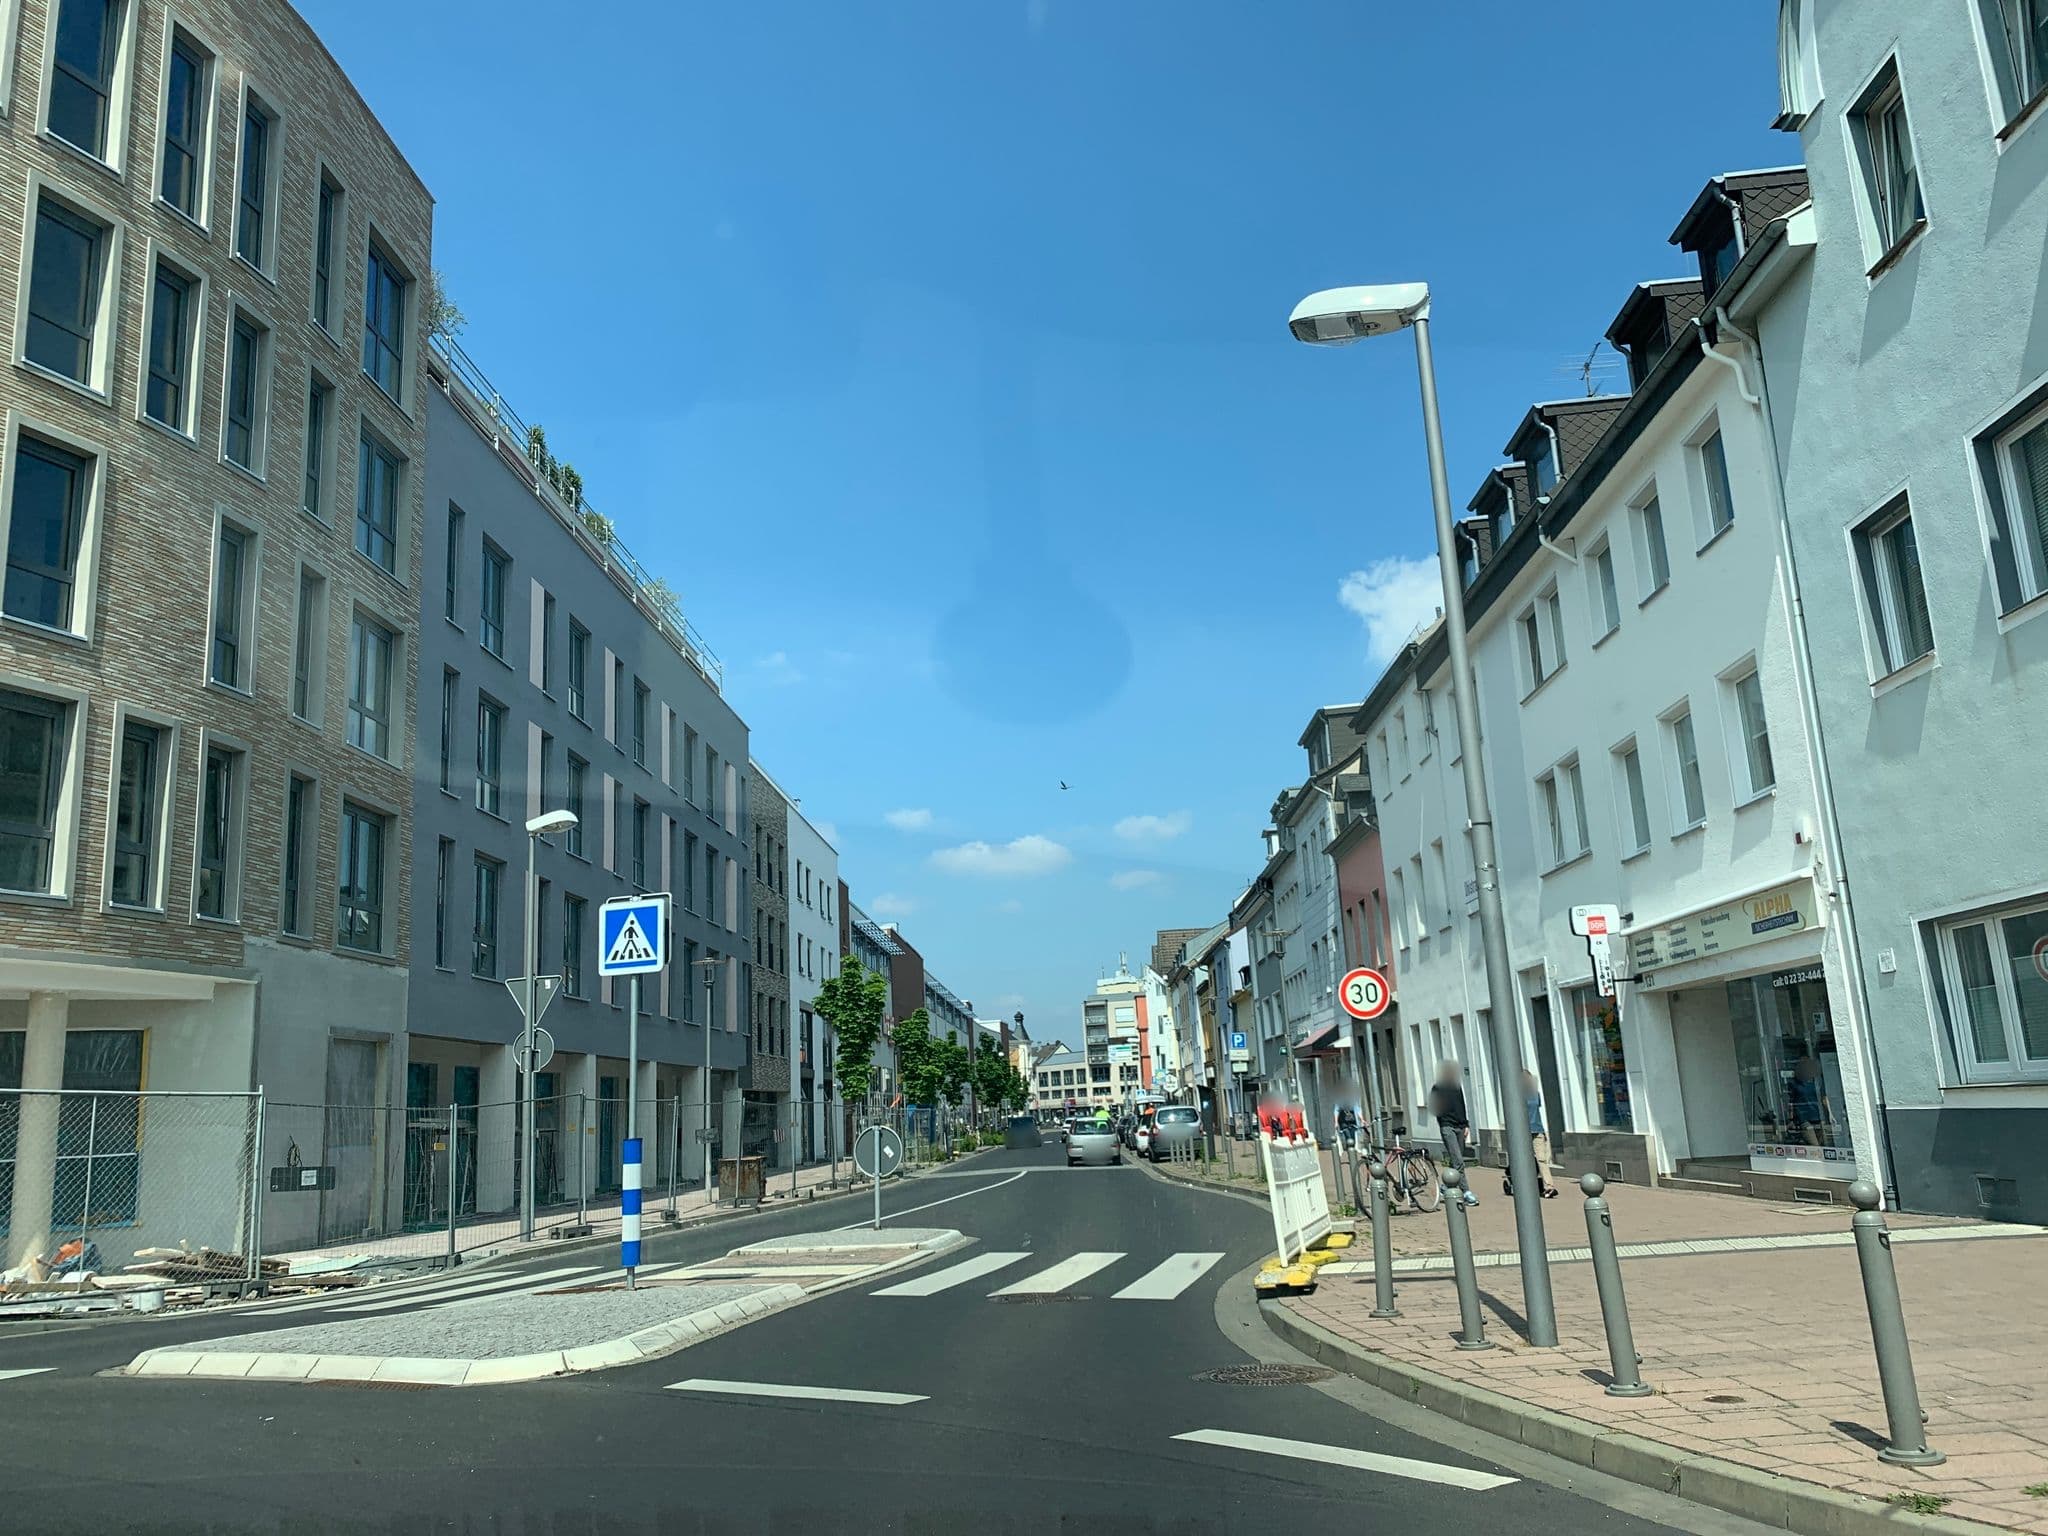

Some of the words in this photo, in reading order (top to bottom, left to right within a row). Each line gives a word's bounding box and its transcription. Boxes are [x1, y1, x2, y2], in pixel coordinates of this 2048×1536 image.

[1754, 893, 1793, 920] ALPHA
[1350, 982, 1378, 1004] 30
[1233, 1034, 1244, 1047] P
